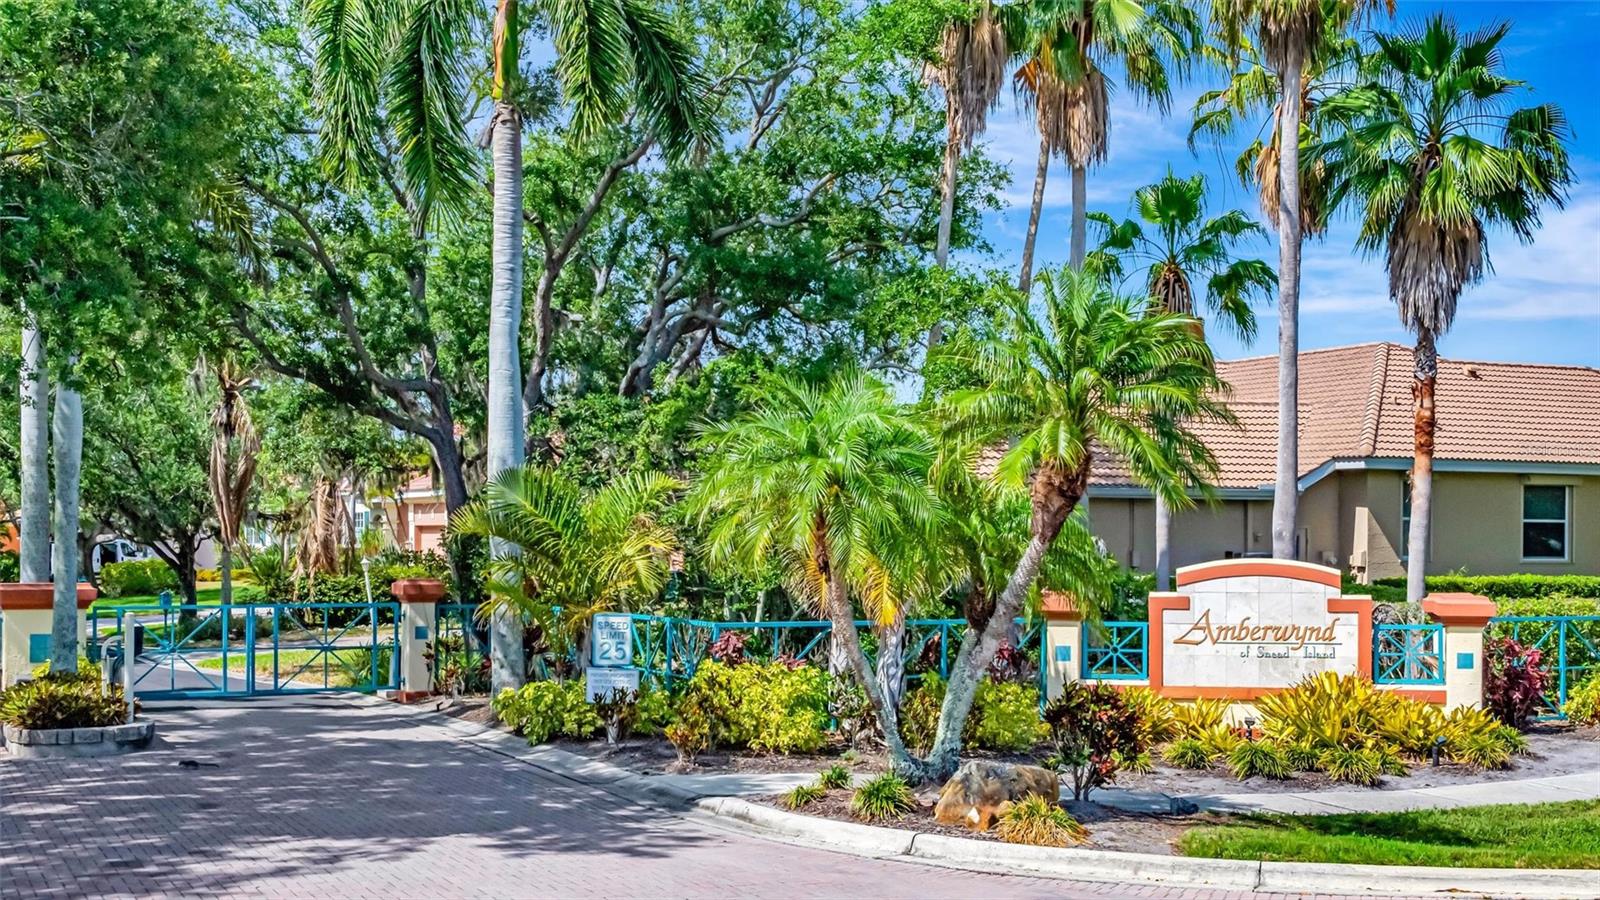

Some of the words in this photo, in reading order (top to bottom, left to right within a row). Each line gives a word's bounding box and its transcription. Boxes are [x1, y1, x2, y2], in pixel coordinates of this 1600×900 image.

[597, 621, 629, 631] SPEED
[1173, 608, 1341, 651] Amberwynd
[600, 631, 626, 640] LIMIT
[599, 641, 627, 661] 25
[1240, 645, 1250, 658] of
[1303, 646, 1336, 659] Island
